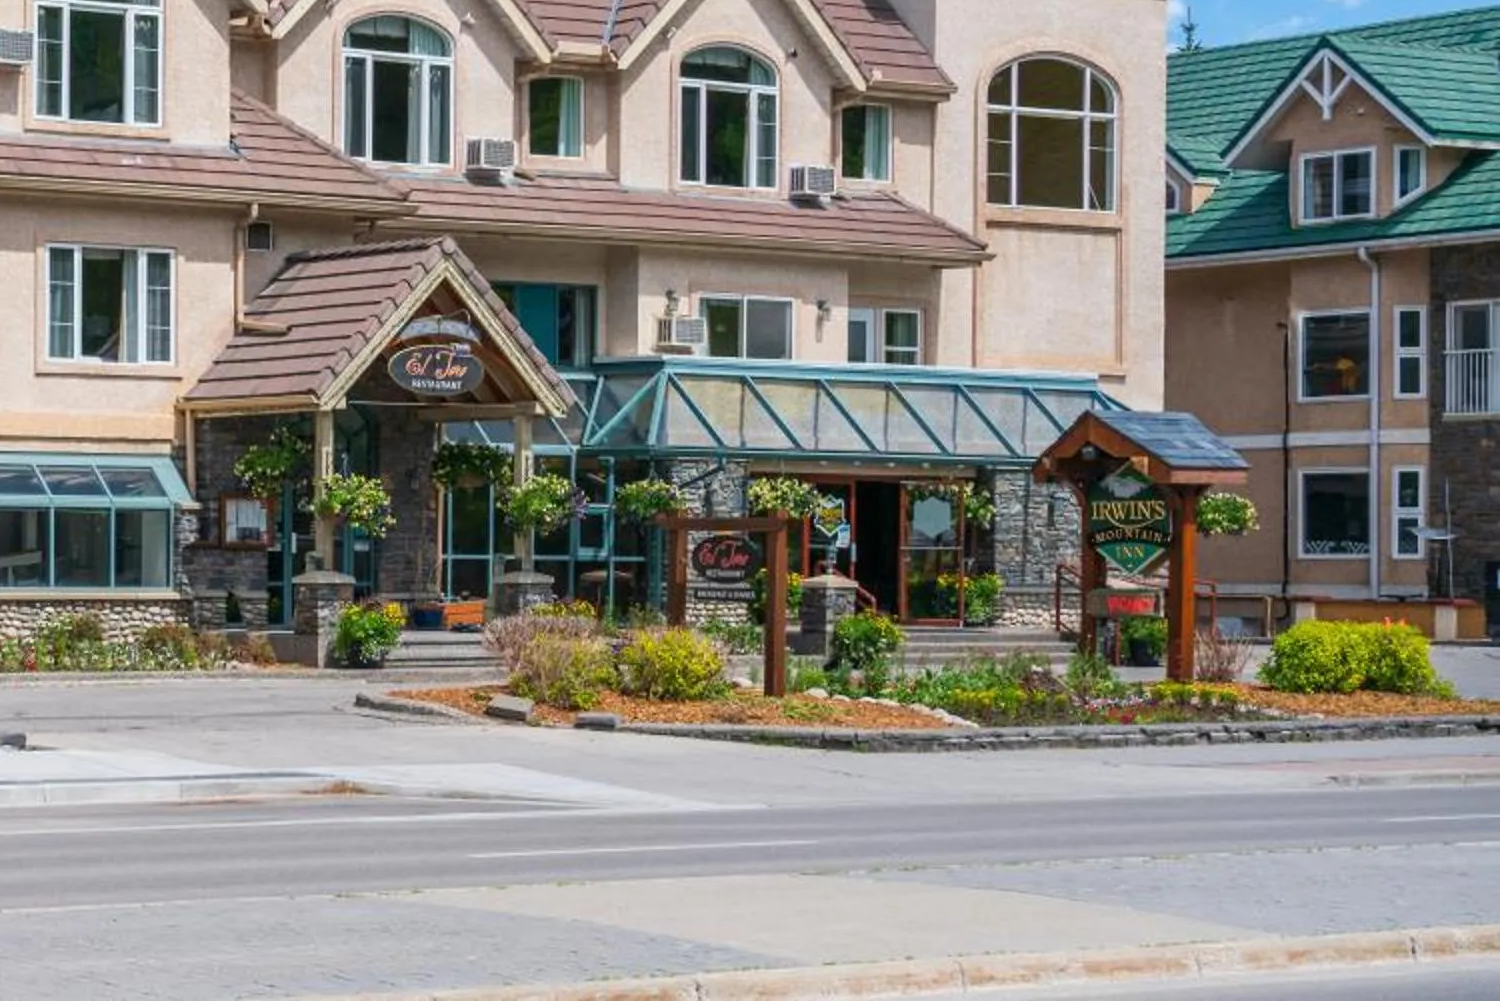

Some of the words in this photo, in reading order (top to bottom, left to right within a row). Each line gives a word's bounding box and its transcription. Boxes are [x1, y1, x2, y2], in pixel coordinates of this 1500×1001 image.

[411, 378, 464, 390] RESTAURANT
[1091, 500, 1166, 526] IRWIN'S
[1094, 527, 1163, 543] MOUNTAIN
[1115, 545, 1145, 559] INN
